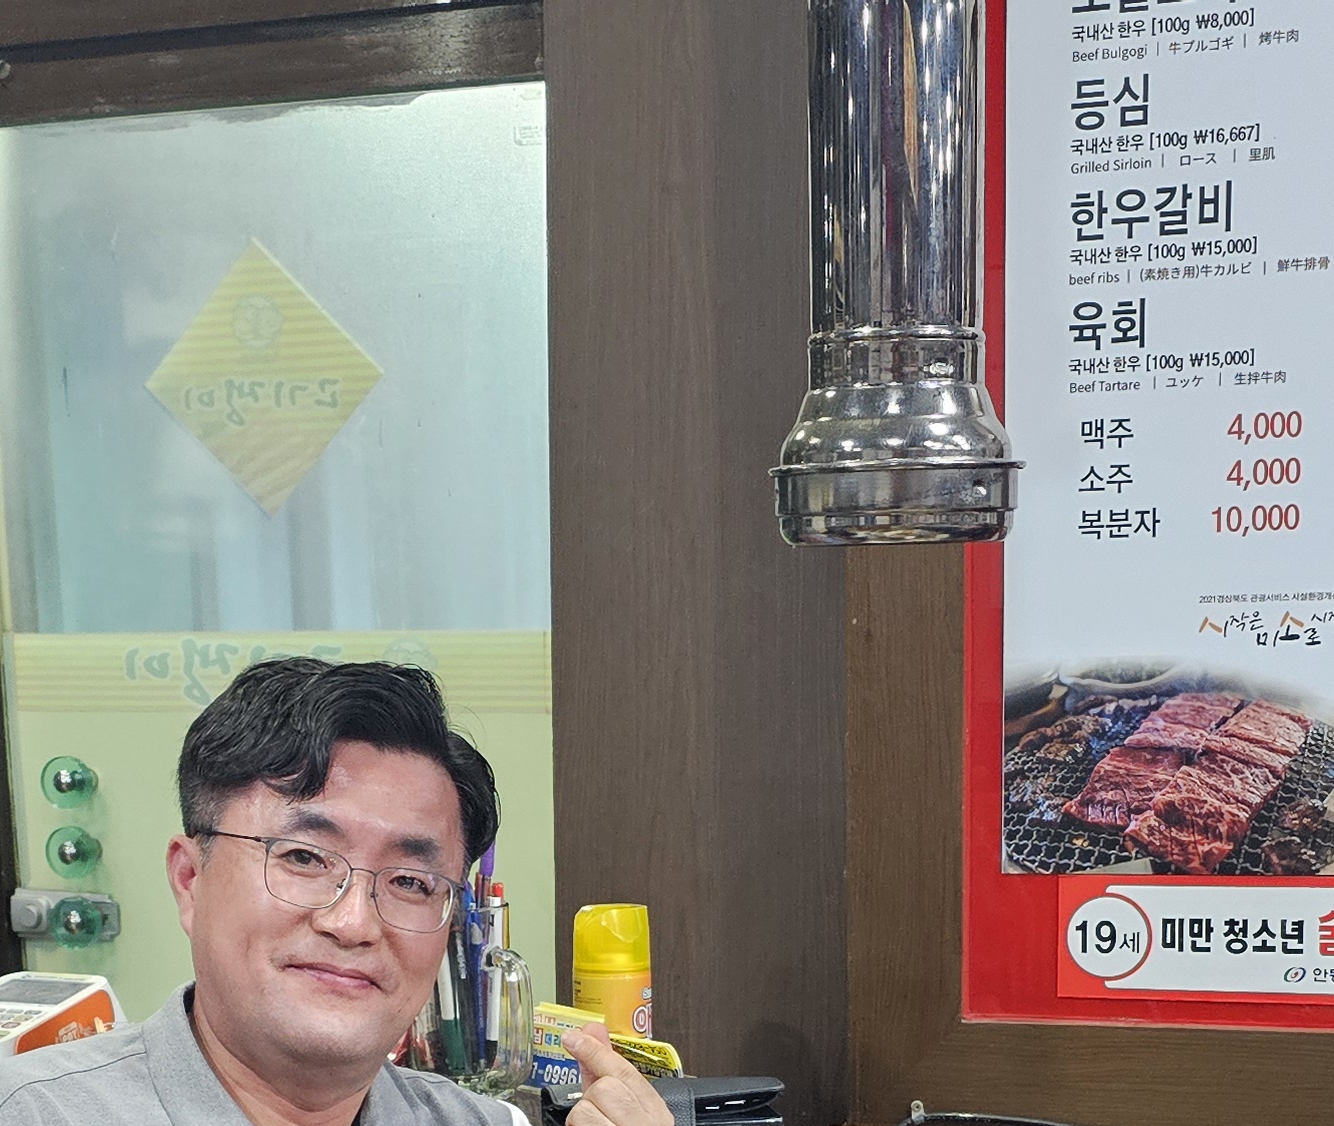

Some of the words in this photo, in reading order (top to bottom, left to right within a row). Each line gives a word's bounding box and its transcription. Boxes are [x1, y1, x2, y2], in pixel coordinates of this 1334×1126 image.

[1071, 21, 1114, 43] 국내산
[1117, 20, 1146, 38] 한우
[1151, 17, 1190, 37] [100g
[1258, 28, 1300, 46] 烤牛肉
[1072, 46, 1099, 62] Beef
[1101, 44, 1148, 62] Bulgogi
[1070, 73, 1150, 131] 등심
[1070, 137, 1113, 156] 국내산
[1116, 134, 1144, 152] 한우
[1149, 131, 1188, 151] [100g
[1249, 146, 1276, 162] 里肌
[1070, 158, 1110, 175] Grilled
[1113, 156, 1152, 171] Sirloin
[1179, 152, 1217, 167] ロース
[1070, 179, 1233, 242] 한우갈비
[1069, 247, 1112, 266] 국내산
[1114, 245, 1143, 264] 한우
[1147, 242, 1186, 262] [100g
[1068, 270, 1096, 286] beef
[1097, 269, 1120, 284] ribs
[1068, 297, 1147, 351] 육회
[1068, 356, 1110, 376] 국내산
[1113, 355, 1141, 373] 한우
[1145, 353, 1184, 372] [100g
[1069, 381, 1096, 394] Beef
[1098, 379, 1141, 392] Tartare
[1165, 375, 1204, 389] ユッケ
[1080, 417, 1135, 449] 맥주
[1227, 410, 1303, 445] 4,000
[1078, 461, 1134, 495] 소주
[1226, 456, 1302, 490] 4,000
[1077, 508, 1161, 541] 복분자
[1210, 503, 1301, 538] 10,000
[1074, 919, 1140, 956] 19세
[1160, 917, 1215, 953] 미만
[1222, 918, 1305, 956] 청소년
